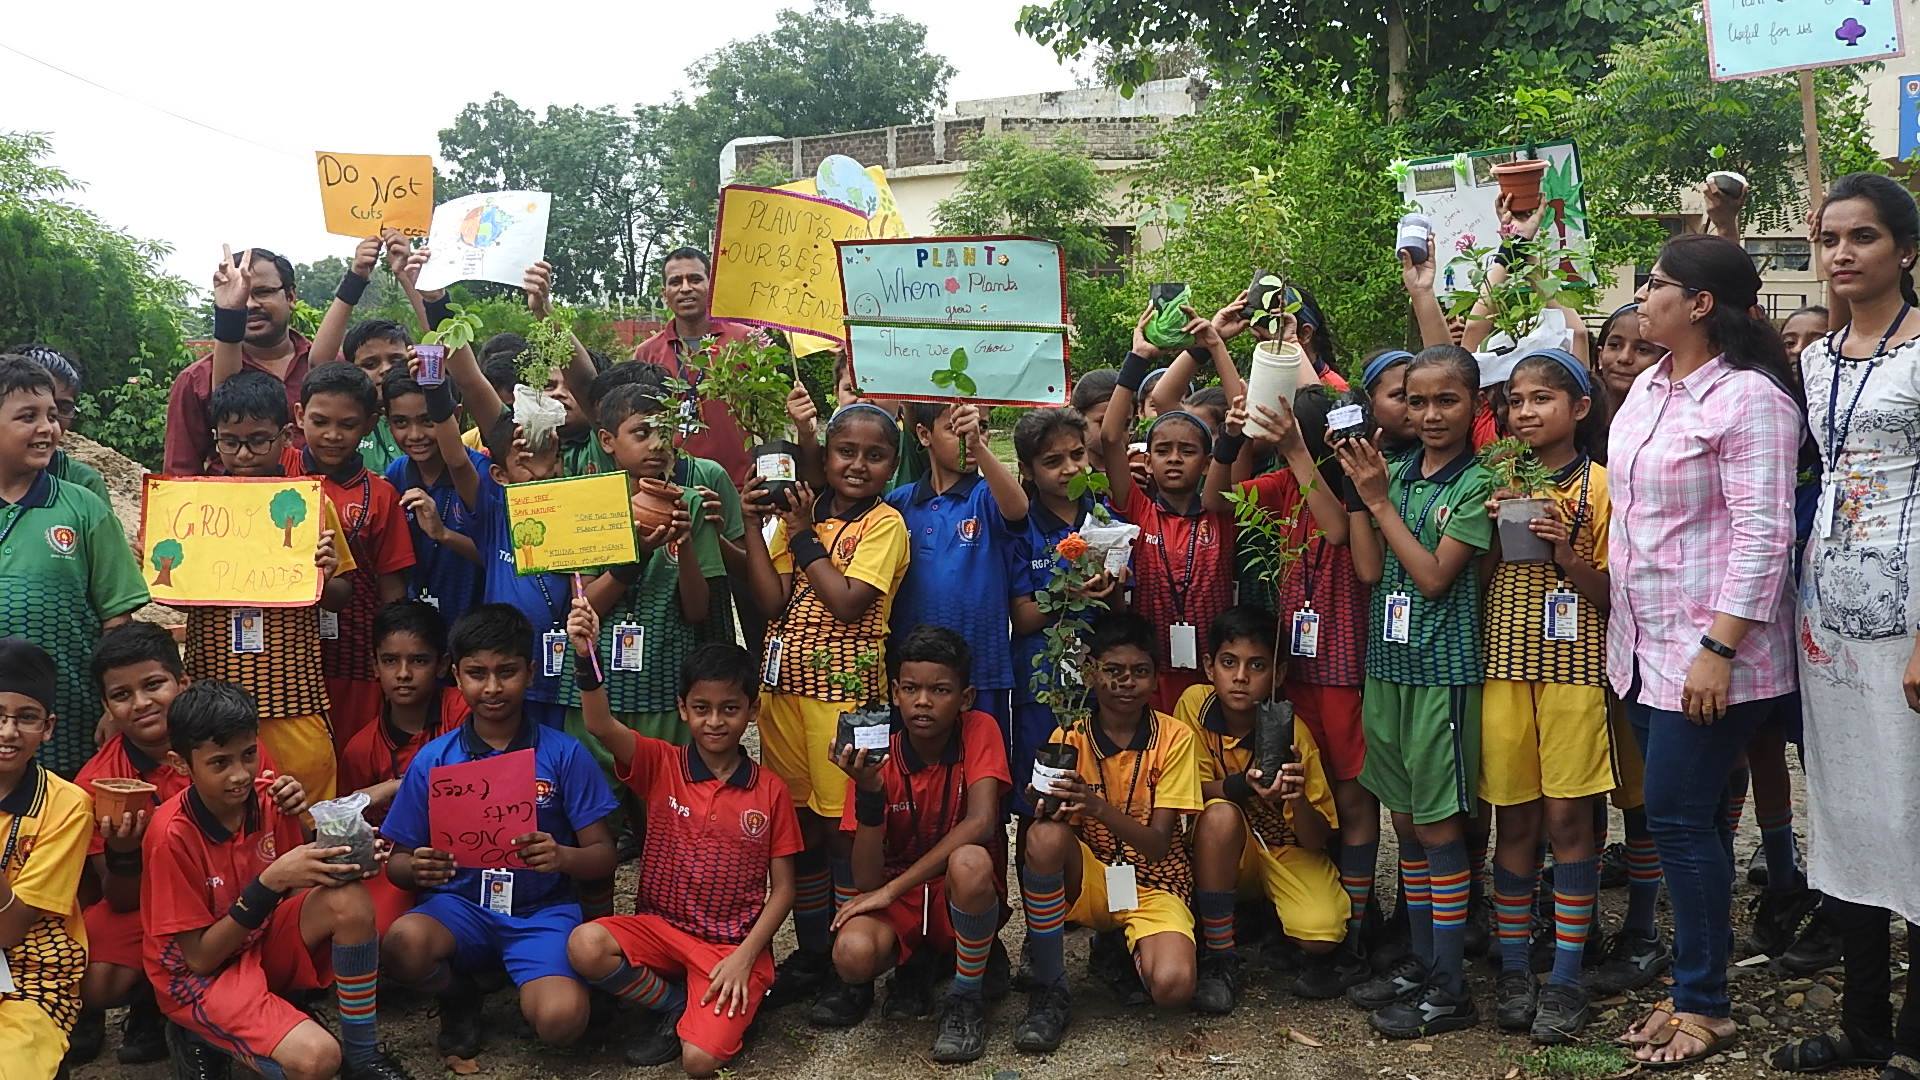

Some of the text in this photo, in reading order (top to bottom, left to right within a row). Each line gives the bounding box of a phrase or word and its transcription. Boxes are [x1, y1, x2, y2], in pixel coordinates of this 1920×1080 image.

[1728, 22, 1760, 45] Useful
[1768, 22, 1790, 45] for
[371, 175, 423, 207] Not
[742, 200, 833, 240] PLANTS
[727, 242, 772, 267] OUR
[917, 246, 996, 268] PLANT
[877, 267, 1018, 303] When Plants
[880, 329, 921, 357] Then
[173, 501, 262, 540] GROW
[213, 561, 304, 593] PLANTS
